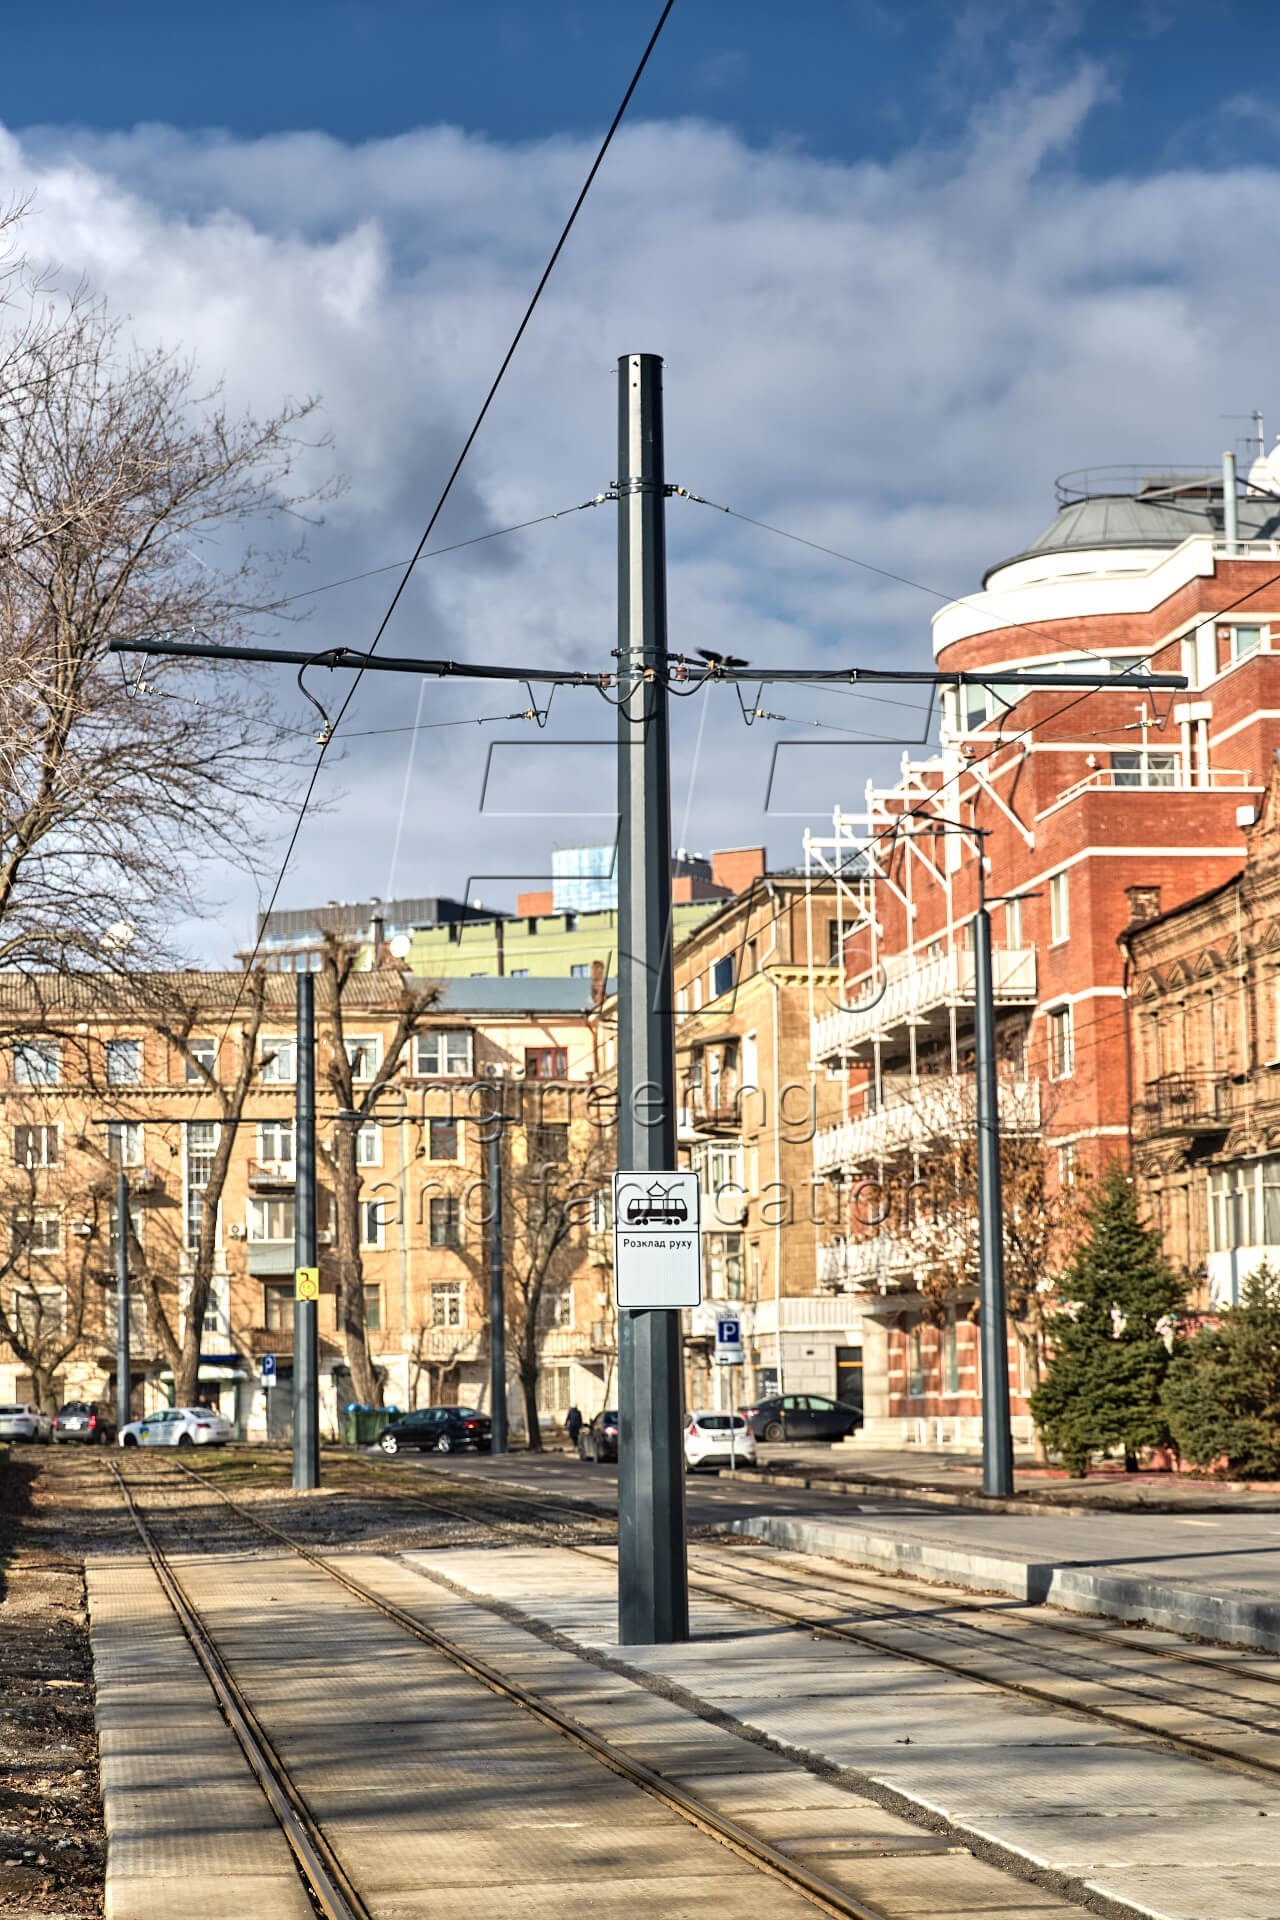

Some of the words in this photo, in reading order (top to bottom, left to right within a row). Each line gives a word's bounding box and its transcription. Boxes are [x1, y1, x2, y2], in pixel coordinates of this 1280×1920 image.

[623, 1238, 666, 1248] Розклад
[669, 1240, 692, 1250] руху
[722, 1323, 737, 1342] P
